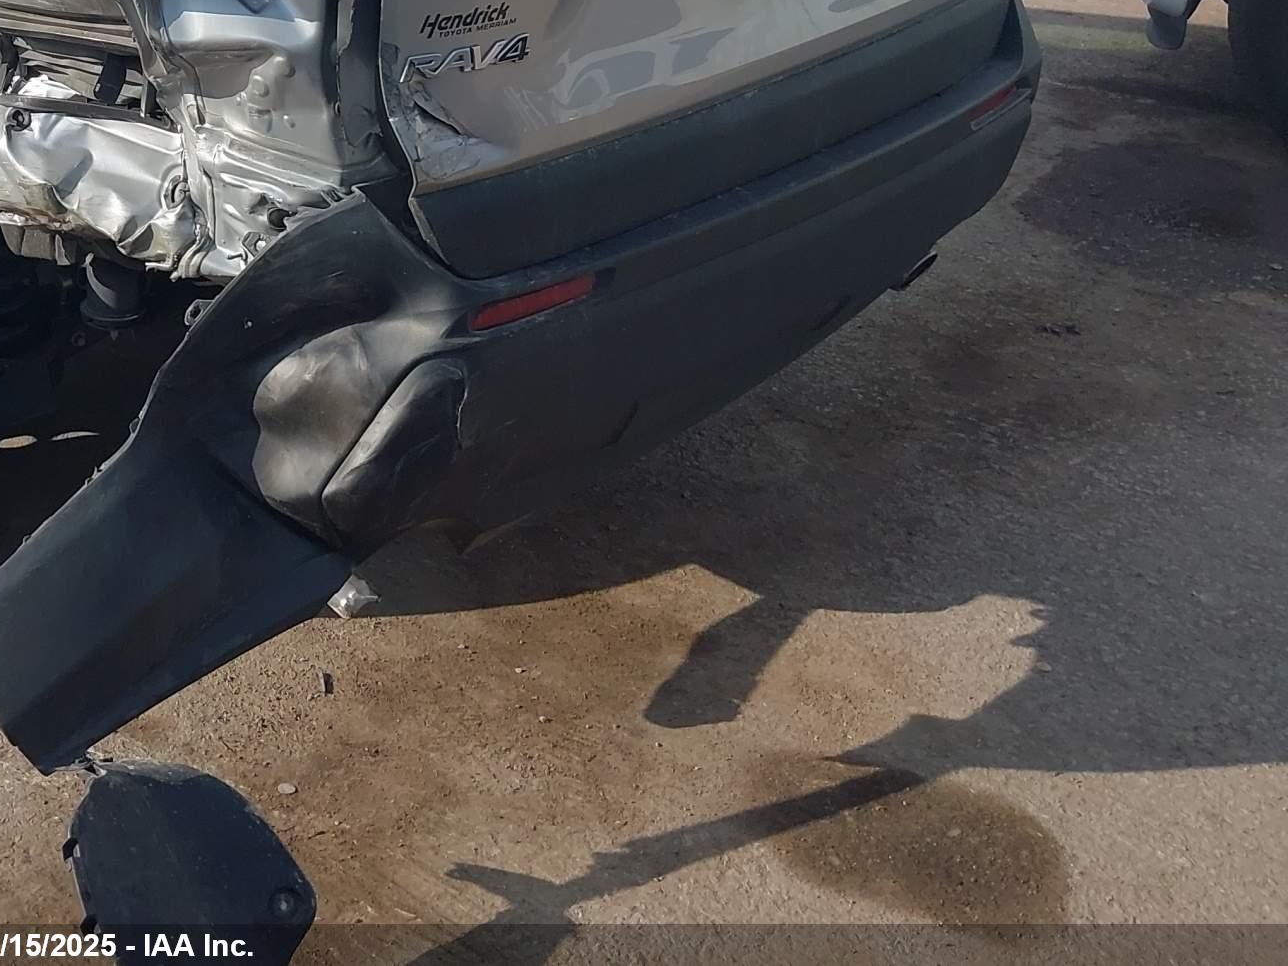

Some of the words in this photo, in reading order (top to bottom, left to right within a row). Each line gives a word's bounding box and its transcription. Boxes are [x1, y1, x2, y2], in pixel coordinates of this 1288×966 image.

[419, 1, 510, 39] Hendrick
[439, 28, 472, 38] TOYOTA
[476, 17, 517, 32] MERRIAM
[399, 32, 532, 83] RAV4
